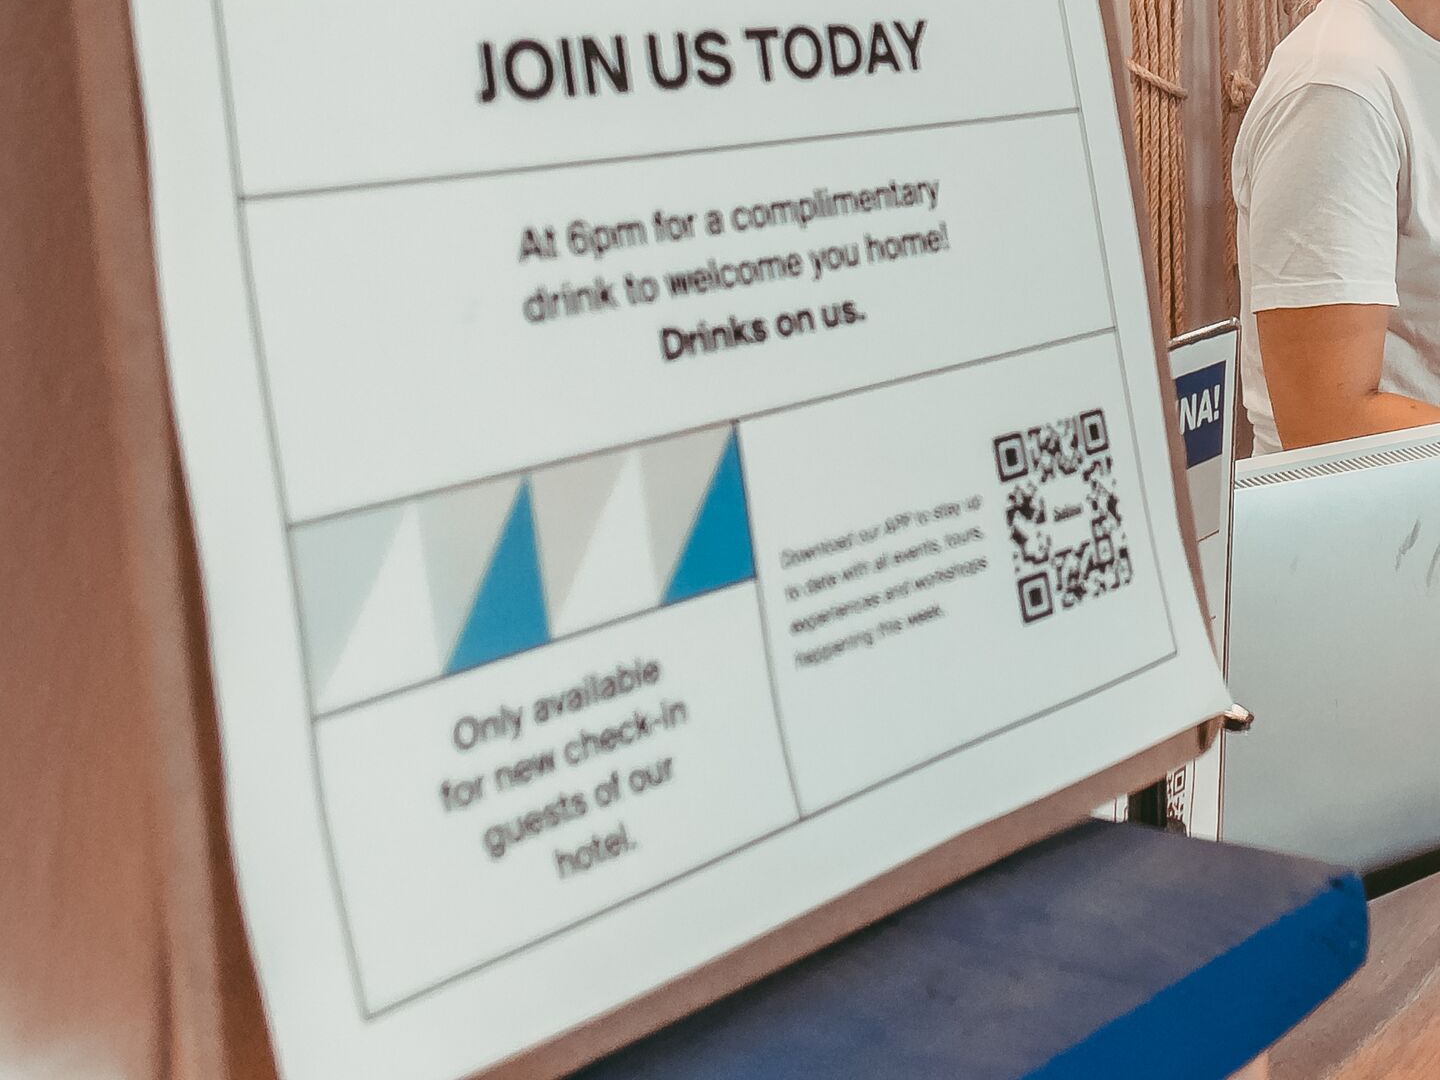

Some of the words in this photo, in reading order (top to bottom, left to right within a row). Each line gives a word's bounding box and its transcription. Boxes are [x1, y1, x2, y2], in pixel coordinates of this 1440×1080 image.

[477, 33, 631, 104] JOIN
[646, 30, 734, 91] US
[745, 19, 927, 83] TODAY
[519, 226, 557, 262] At
[567, 218, 647, 259] 6pm
[655, 210, 695, 243] for
[704, 209, 725, 237] a
[731, 178, 940, 231] complimentary
[522, 278, 618, 323] drink
[625, 273, 659, 306] to
[665, 252, 802, 297] welcome
[809, 240, 860, 280] you
[865, 222, 950, 265] home!
[660, 315, 768, 362] Drinks
[777, 307, 816, 339] on
[822, 298, 867, 330] us.
[453, 704, 523, 750] Only
[533, 658, 661, 724] available
[441, 776, 485, 811] for
[494, 751, 555, 790] new
[563, 700, 688, 765] check-in
[483, 793, 589, 859] guests
[595, 770, 621, 807] of
[628, 757, 673, 793] our
